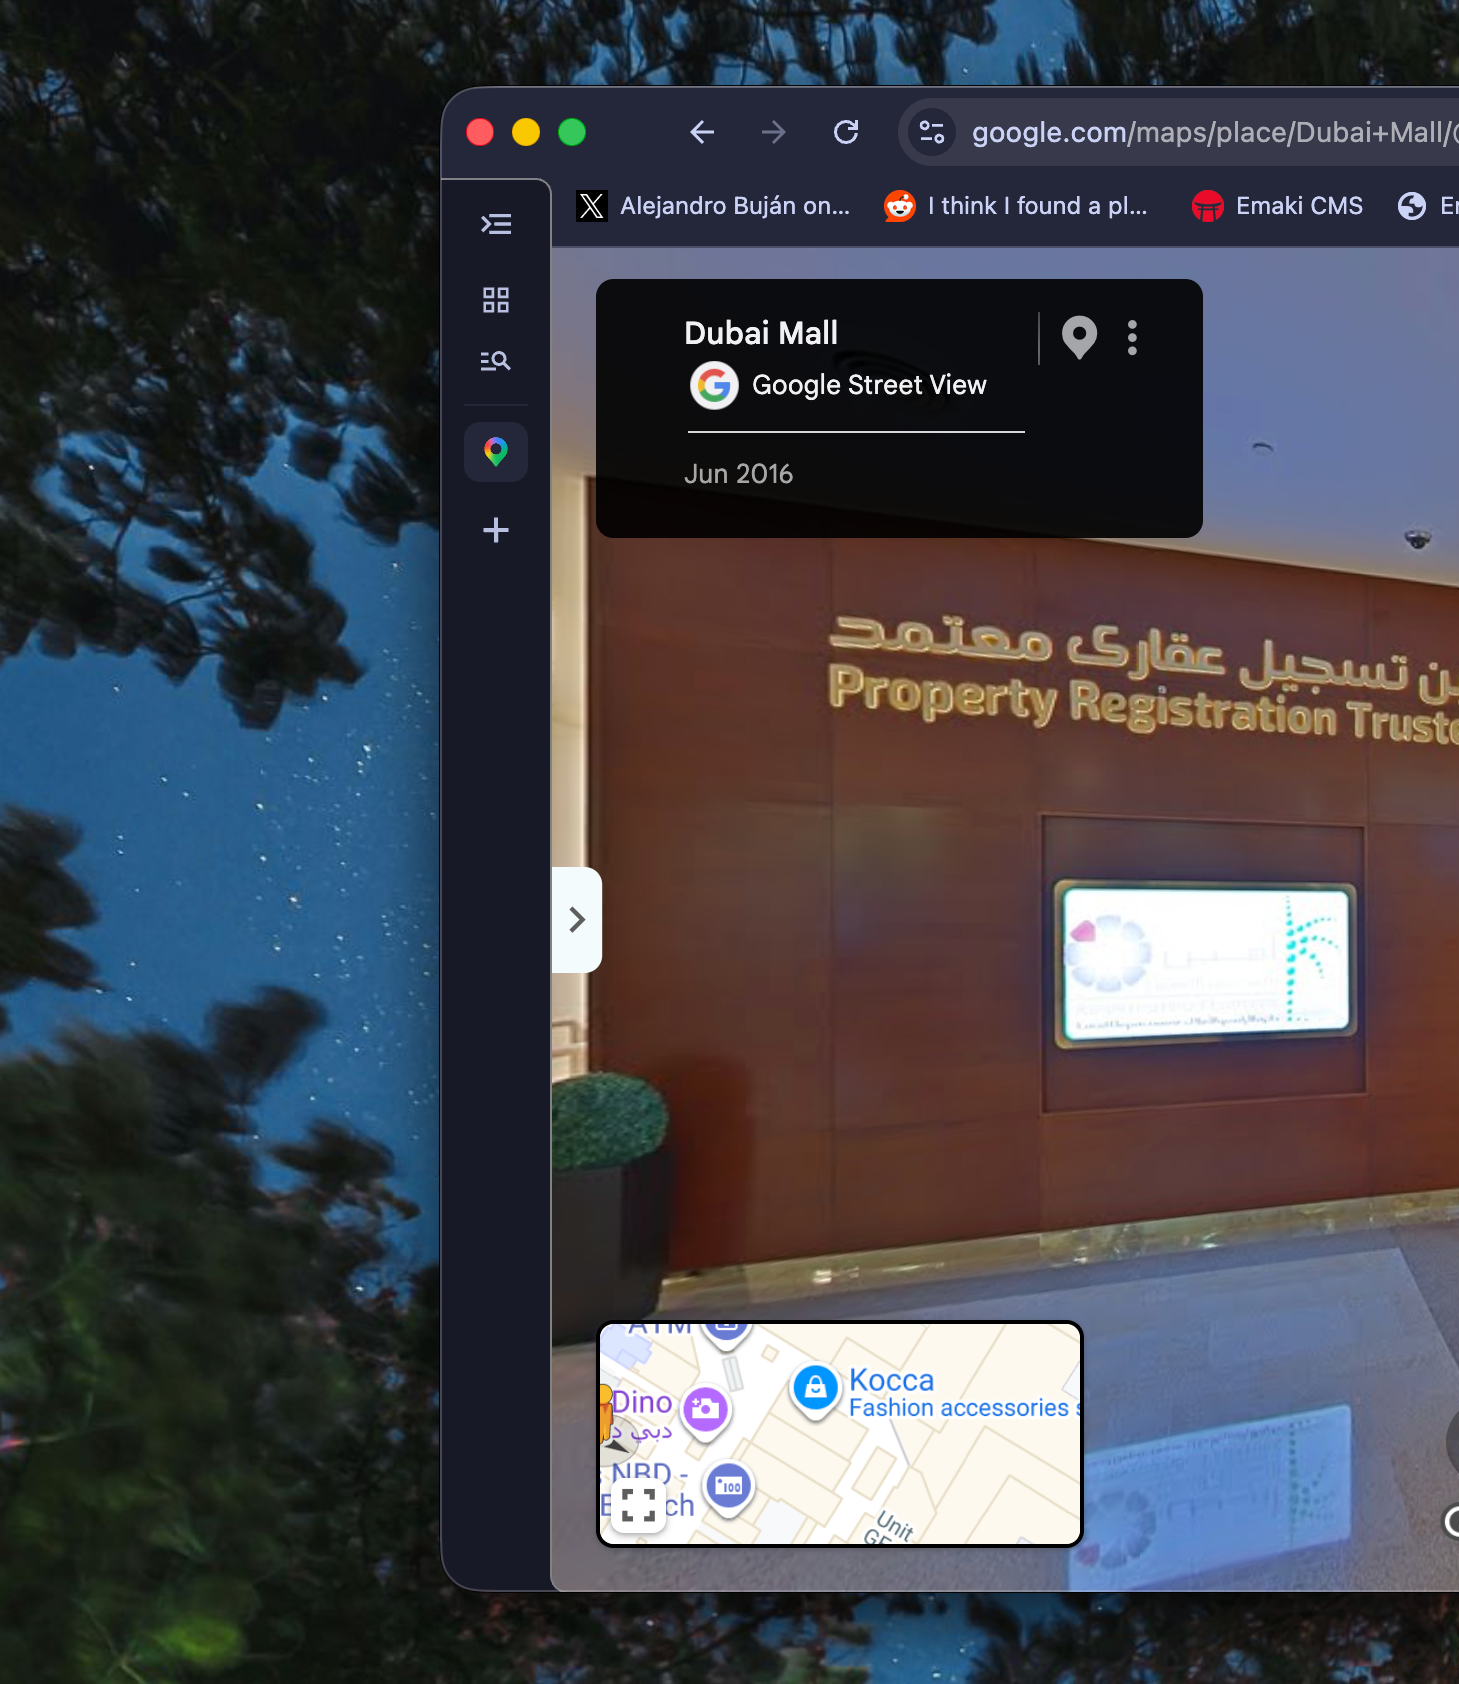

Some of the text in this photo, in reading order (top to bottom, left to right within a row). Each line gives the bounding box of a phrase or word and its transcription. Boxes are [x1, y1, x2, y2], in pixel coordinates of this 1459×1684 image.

[619, 194, 850, 220] Alejandro Buján on...
[929, 195, 1147, 220] I think I found a pl...
[1237, 195, 1364, 216] Emaki CMS
[685, 318, 838, 346] Dubai Mall
[752, 372, 988, 401] Google Street View
[684, 462, 794, 485] Jun 2016
[829, 615, 1053, 662] معتمد
[1239, 639, 1409, 695] تسجيل
[828, 663, 1058, 729] Property
[1068, 678, 1337, 736] Registration
[850, 1367, 934, 1392] Kocca
[613, 1389, 672, 1413] Dino
[850, 1396, 934, 1417] Fashion
[940, 1397, 1070, 1417] accessories
[630, 1426, 673, 1444] دبي
[876, 1509, 914, 1543] Unit
